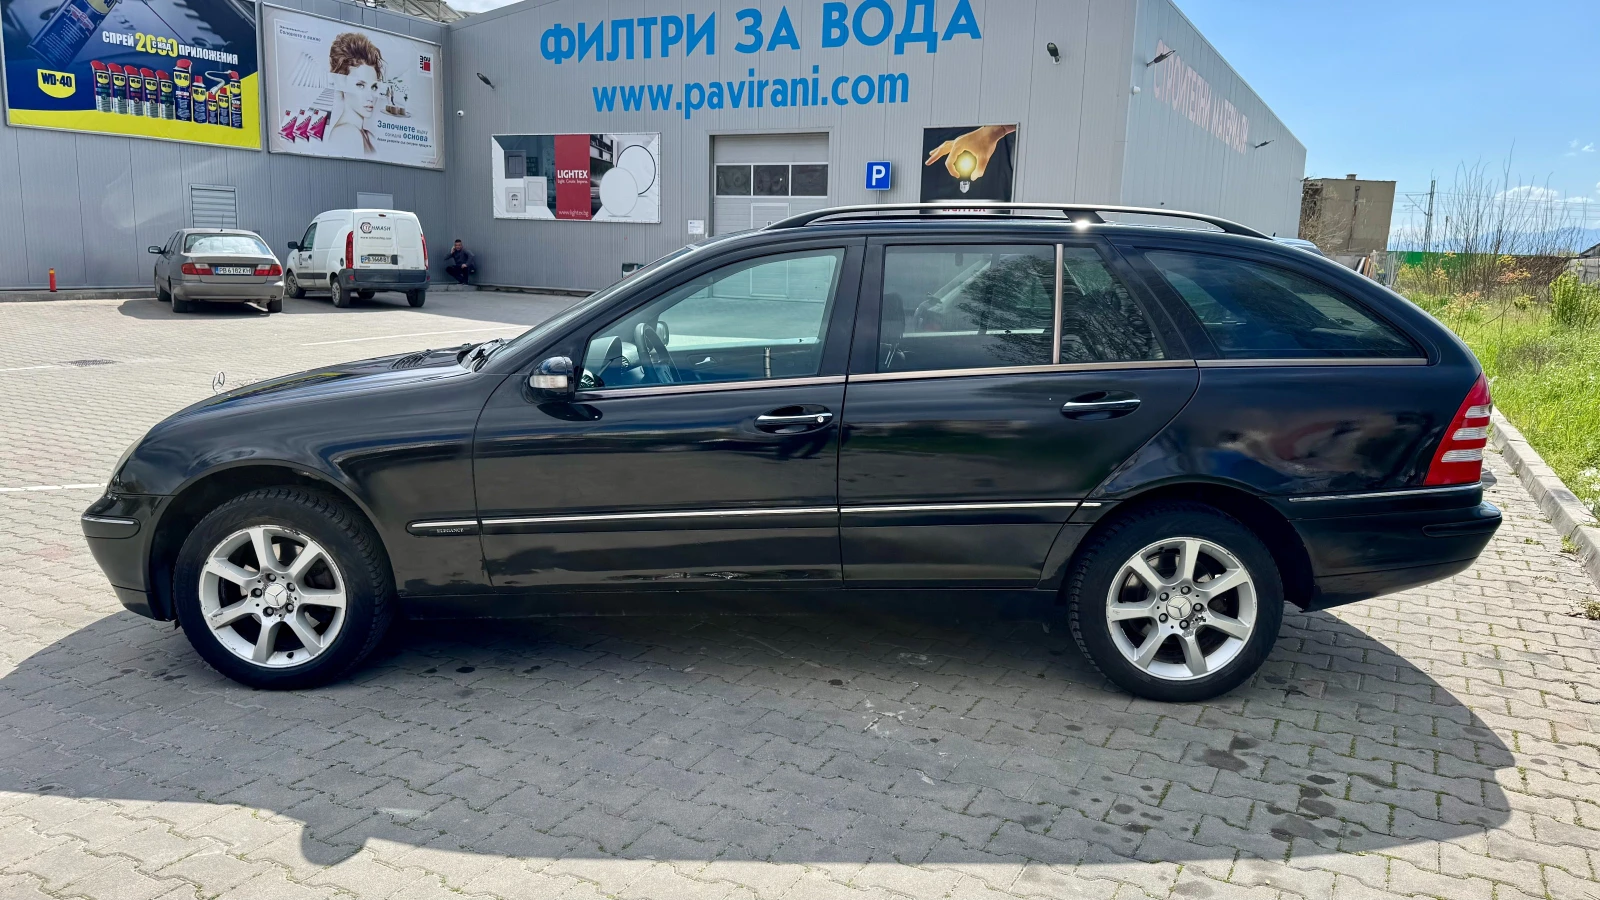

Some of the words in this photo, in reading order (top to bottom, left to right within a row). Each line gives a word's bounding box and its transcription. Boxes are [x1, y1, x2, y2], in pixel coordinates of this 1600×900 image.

[540, 11, 716, 65] ФИЛТРИ
[735, 6, 801, 54] ЗА
[821, 0, 982, 54] ВОДА
[102, 30, 134, 47] СПРЕЙ
[178, 44, 239, 65] ПРИЛОЖЕНИЯ
[40, 72, 73, 88] WD-40
[592, 65, 910, 119] www.pavirani.com
[377, 120, 416, 133] Започнете
[402, 133, 428, 142] основа
[557, 169, 588, 179] LIGHTEX
[871, 166, 885, 185] P
